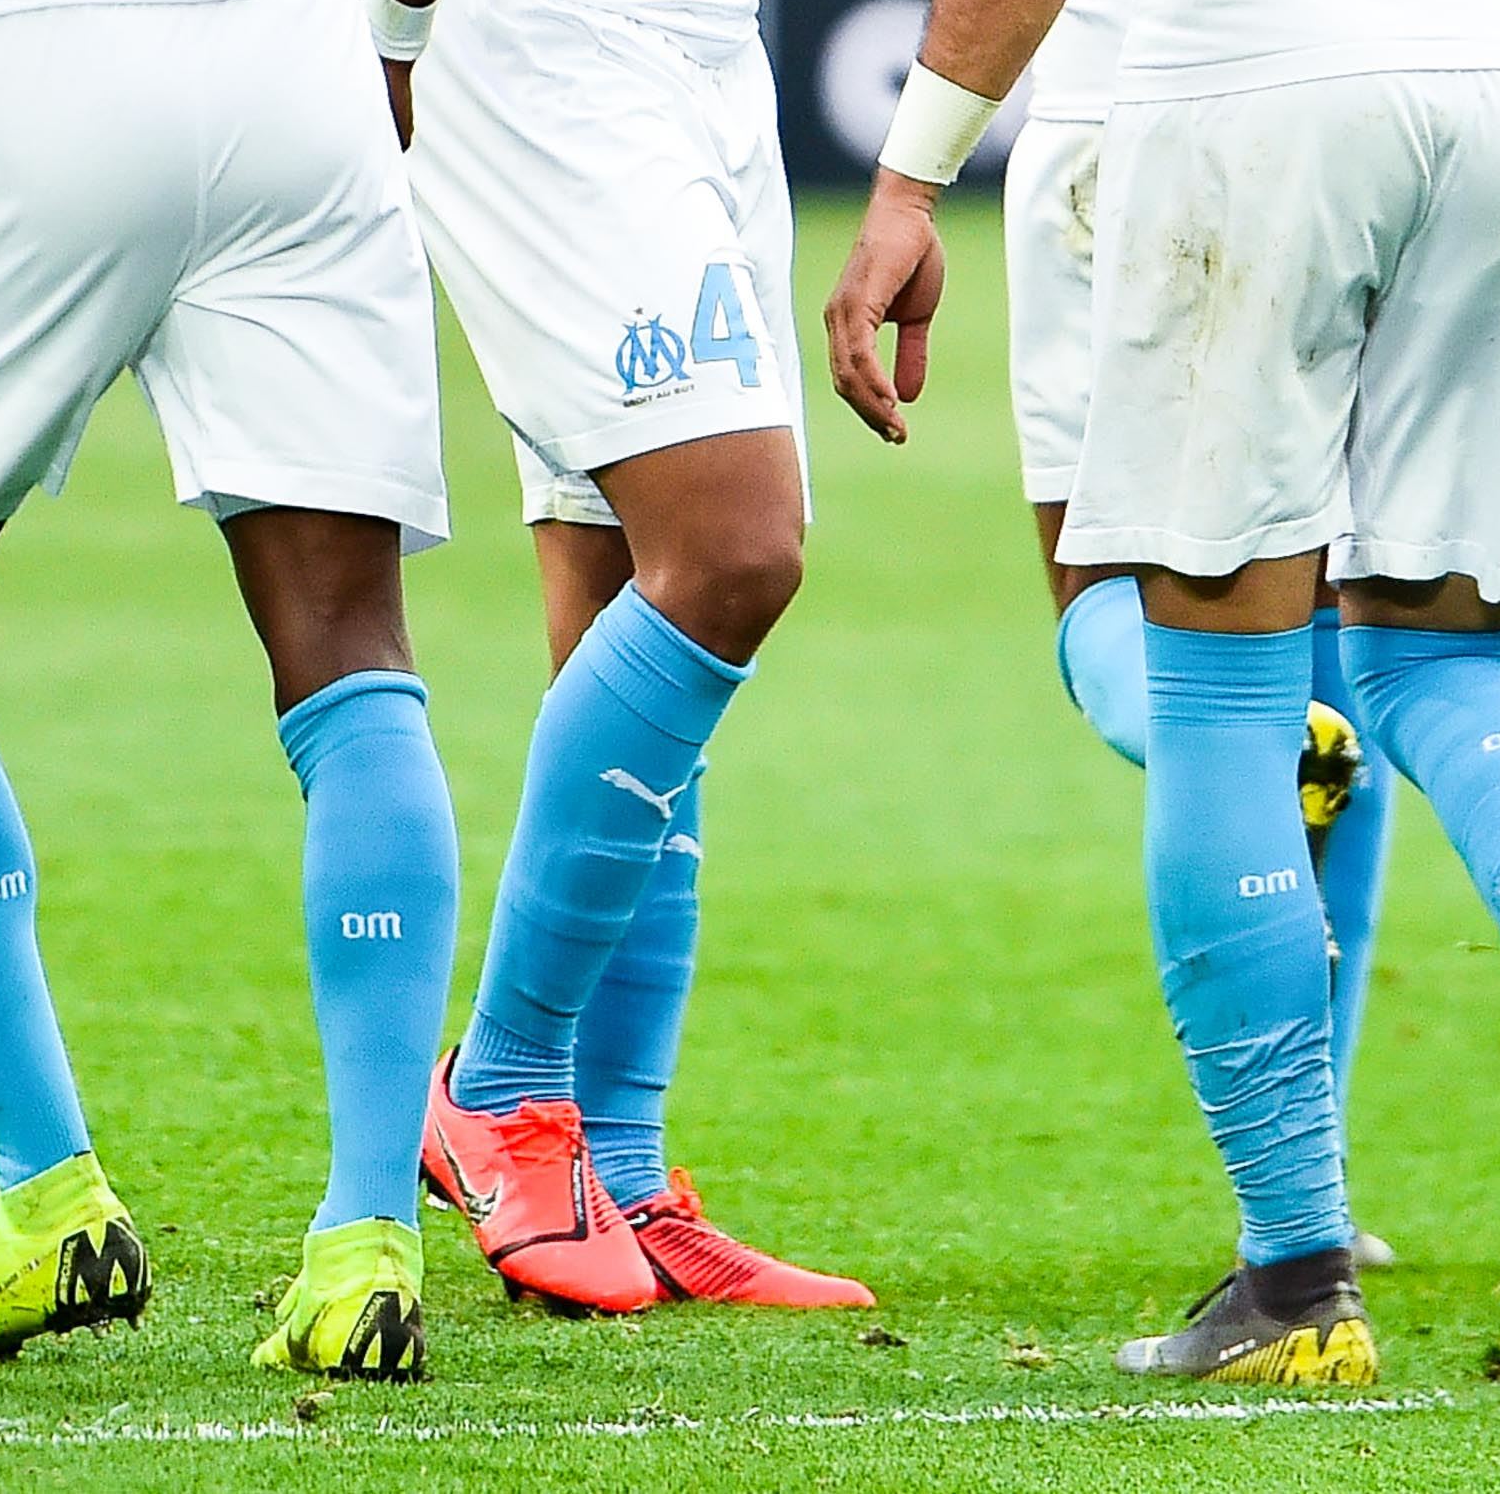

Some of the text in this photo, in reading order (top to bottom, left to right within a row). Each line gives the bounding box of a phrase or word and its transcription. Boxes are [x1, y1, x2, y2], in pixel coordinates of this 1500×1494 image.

[689, 262, 762, 388] 4
[1238, 866, 1299, 899] om
[340, 911, 403, 940] om
